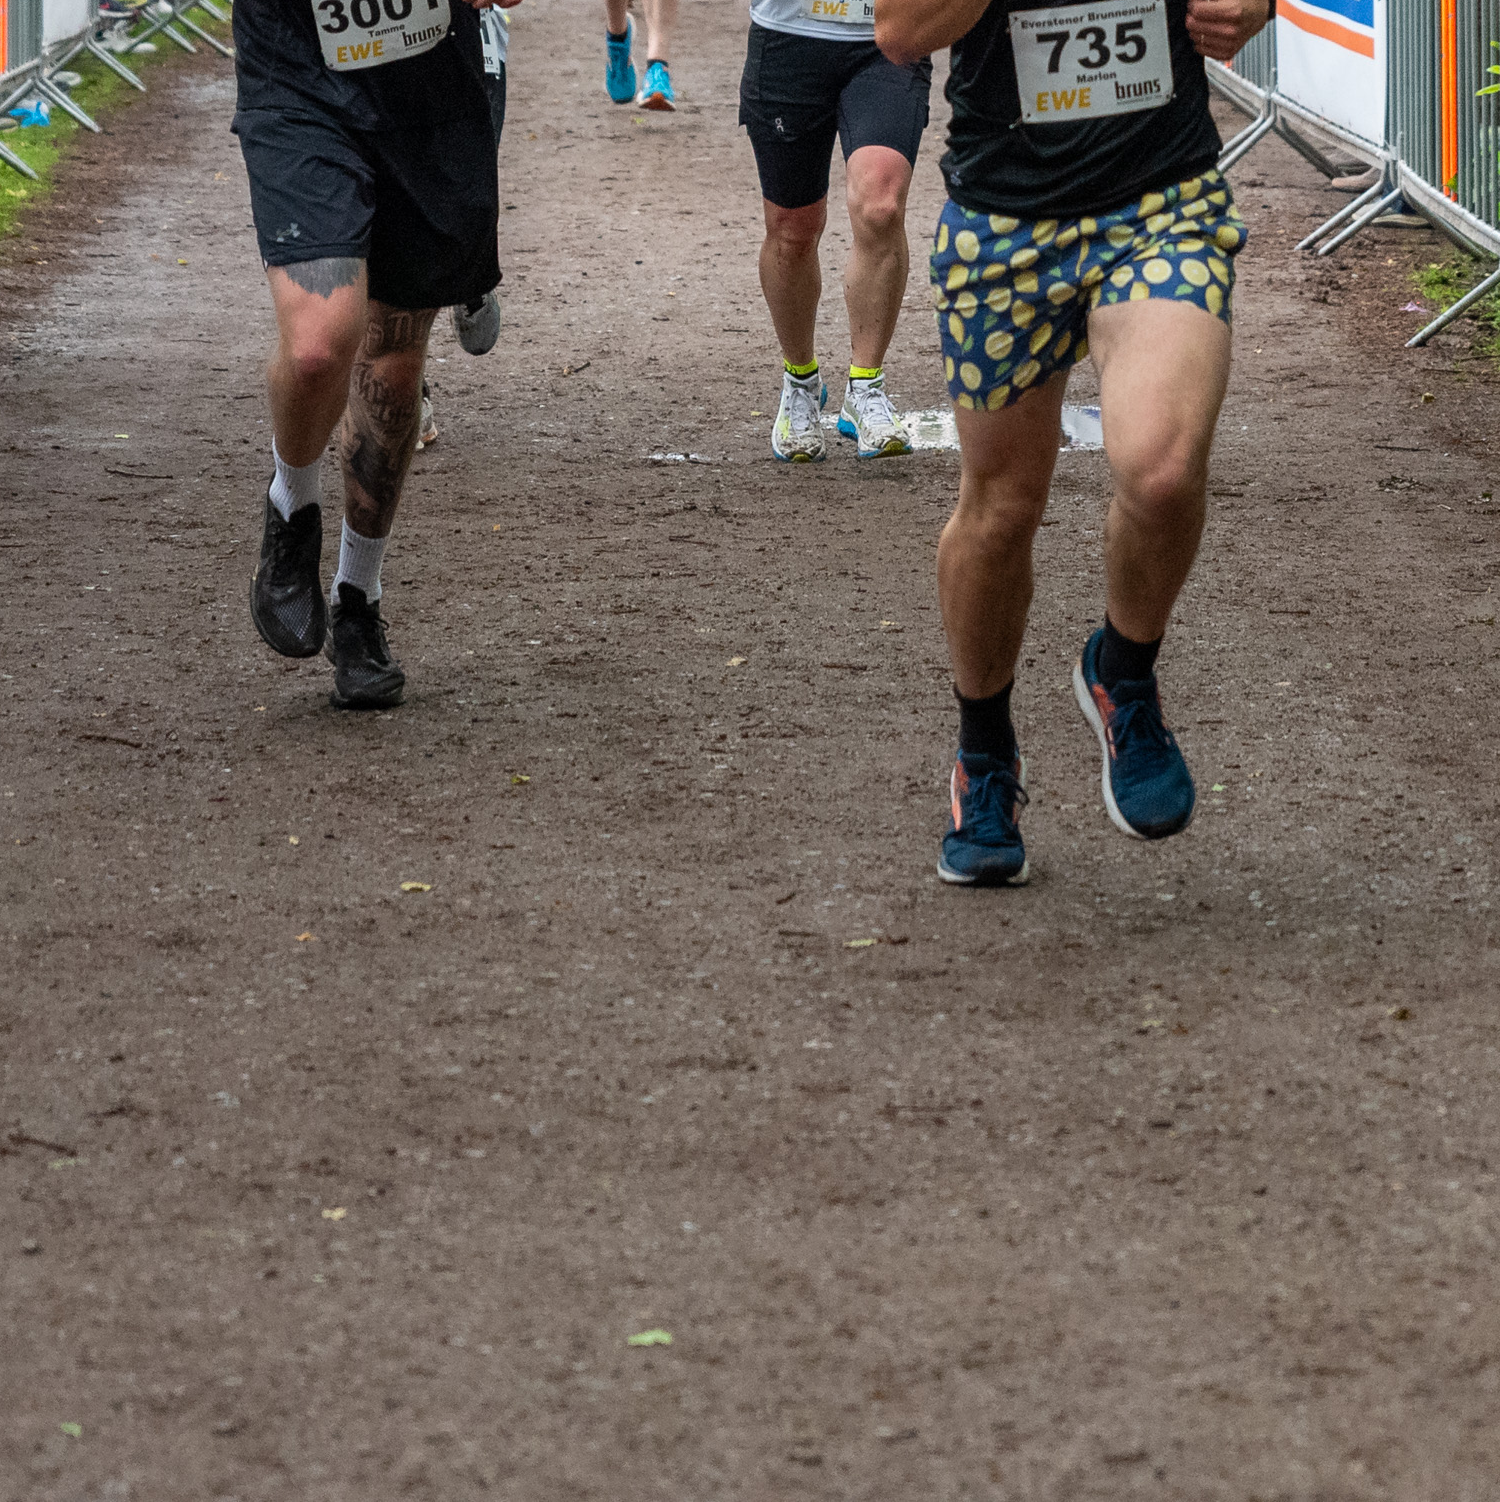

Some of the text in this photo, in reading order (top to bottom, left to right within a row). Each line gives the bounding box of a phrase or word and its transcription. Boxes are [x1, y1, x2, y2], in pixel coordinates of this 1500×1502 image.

[811, 0, 850, 16] EWE
[1020, 3, 1157, 30] Everstener Brunnenlauf
[336, 39, 385, 63] EWE
[402, 24, 443, 47] bruns
[367, 24, 406, 38] Tamme
[1035, 19, 1148, 75] 735
[1035, 87, 1092, 112] EWE
[1114, 78, 1162, 100] bruns
